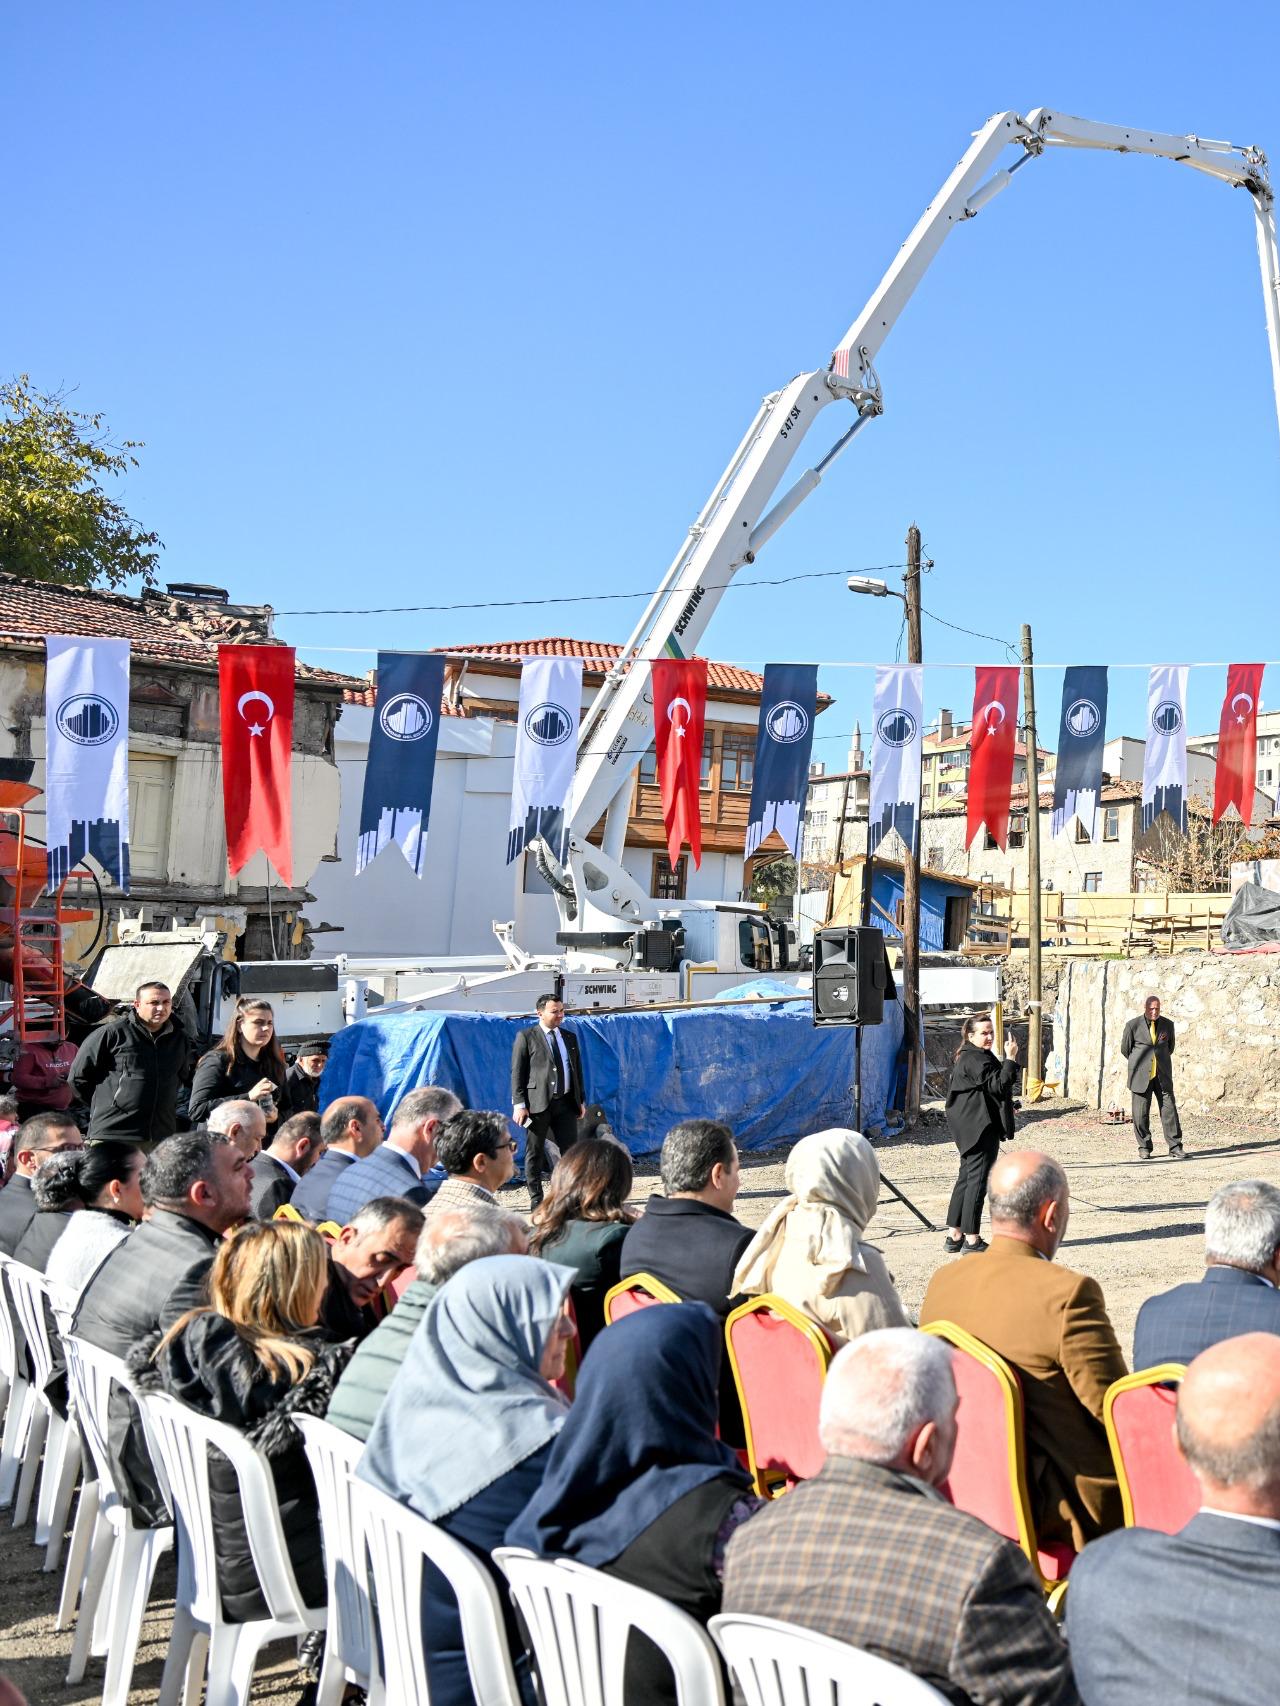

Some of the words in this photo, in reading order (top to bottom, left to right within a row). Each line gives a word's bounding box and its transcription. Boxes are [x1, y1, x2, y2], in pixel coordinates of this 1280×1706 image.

[780, 429, 788, 439] S
[784, 417, 794, 431] 47
[790, 404, 801, 420] SX
[674, 584, 706, 636] SCHWING
[584, 984, 617, 995] SCHWING
